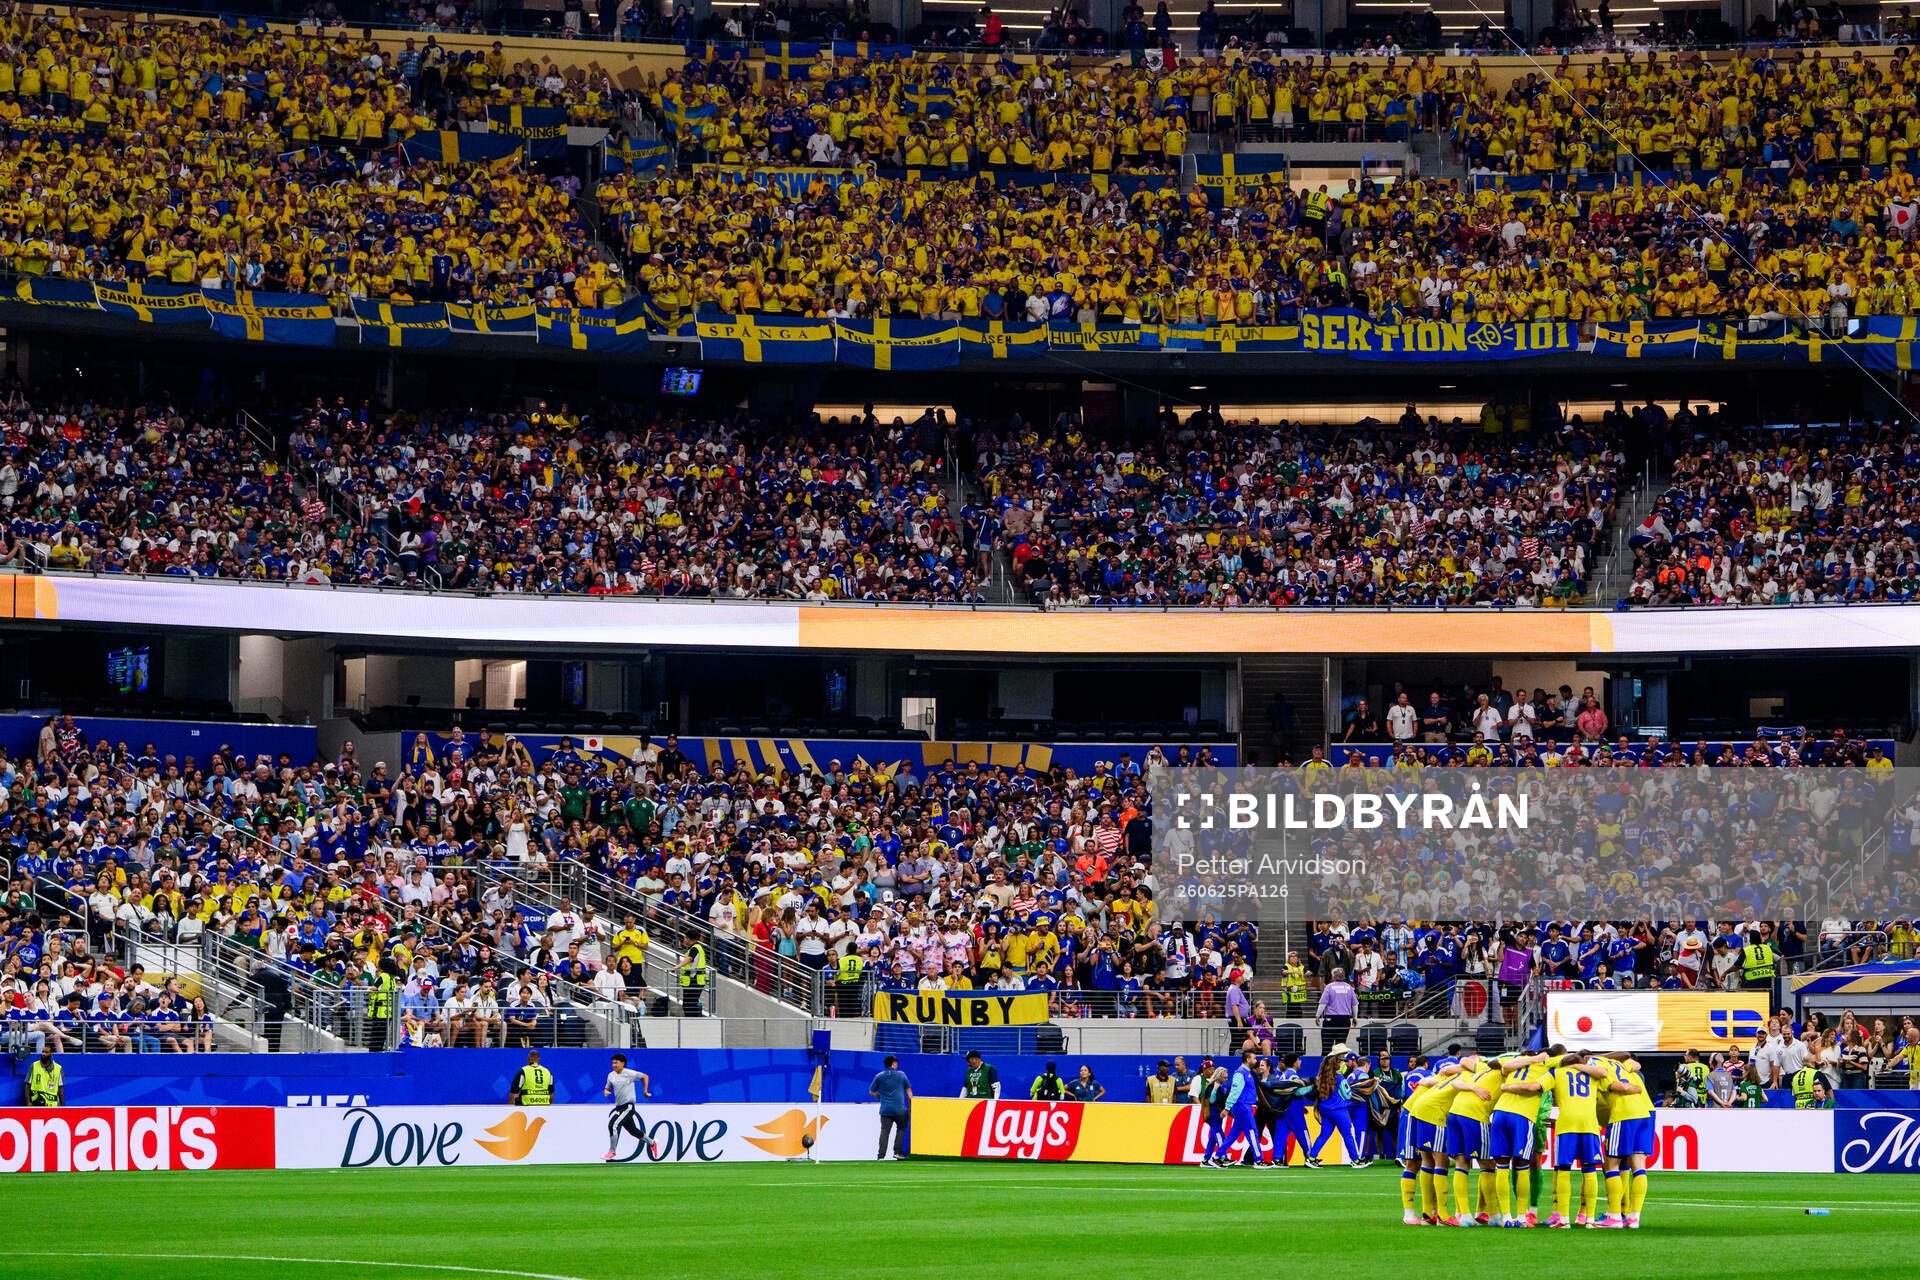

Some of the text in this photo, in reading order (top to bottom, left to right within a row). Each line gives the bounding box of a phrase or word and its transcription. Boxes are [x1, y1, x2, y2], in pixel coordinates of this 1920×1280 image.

[497, 121, 560, 137] HUDDINGE
[1206, 176, 1260, 185] MOTALA
[100, 289, 186, 308] SANNAHEDS
[188, 295, 201, 305] IF
[211, 300, 318, 318] KARLSKOGA
[465, 308, 506, 320] VIKA
[709, 324, 809, 340] SPÅNGA
[1212, 328, 1264, 340] FALUN
[1302, 314, 1570, 351] SEKTION 101
[890, 995, 1016, 1026] RUNBY
[1565, 1070, 1591, 1098] 18
[287, 1094, 367, 1107] FIFA
[340, 1107, 463, 1168] Dove
[977, 1100, 1070, 1160] Lay's
